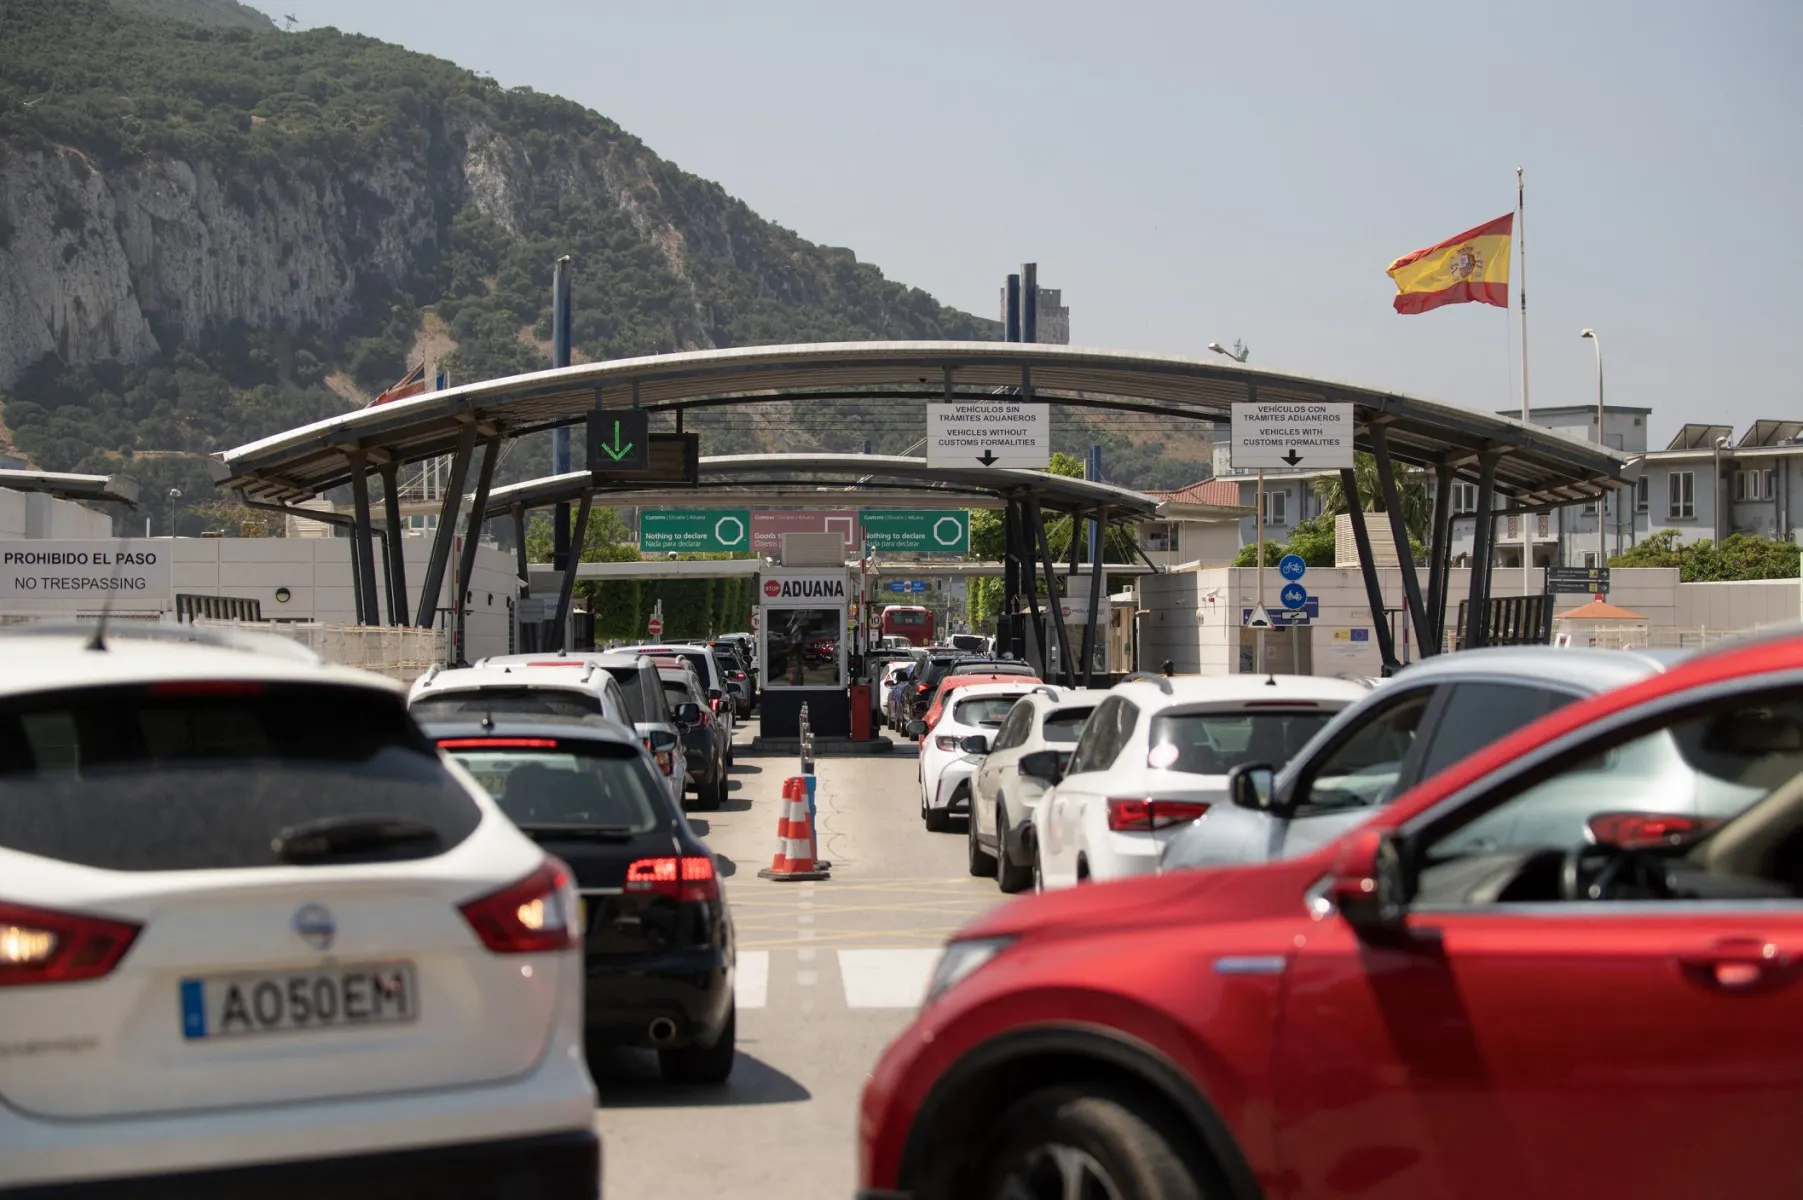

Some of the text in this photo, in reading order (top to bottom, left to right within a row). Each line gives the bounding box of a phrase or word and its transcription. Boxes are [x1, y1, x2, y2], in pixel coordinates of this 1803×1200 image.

[955, 405, 1004, 413] VEHÍCULOS
[1258, 404, 1306, 413] VEHÍCULOS
[939, 413, 1036, 422] TRÁMITES ADUANEROS
[1244, 413, 1341, 422] TRÁMITES ADUANEROS
[1259, 428, 1323, 436] VEHICLES WITH
[1243, 438, 1340, 446] CUSTOMS FORMALITIES
[645, 532, 672, 541] Nothing
[683, 532, 708, 540] declare
[901, 532, 926, 540] declare
[4, 552, 157, 565] PROHIBIDO EL PASO
[14, 577, 146, 590] NO TRESPASSING
[781, 580, 845, 598] ADUANA
[870, 616, 880, 625] 10
